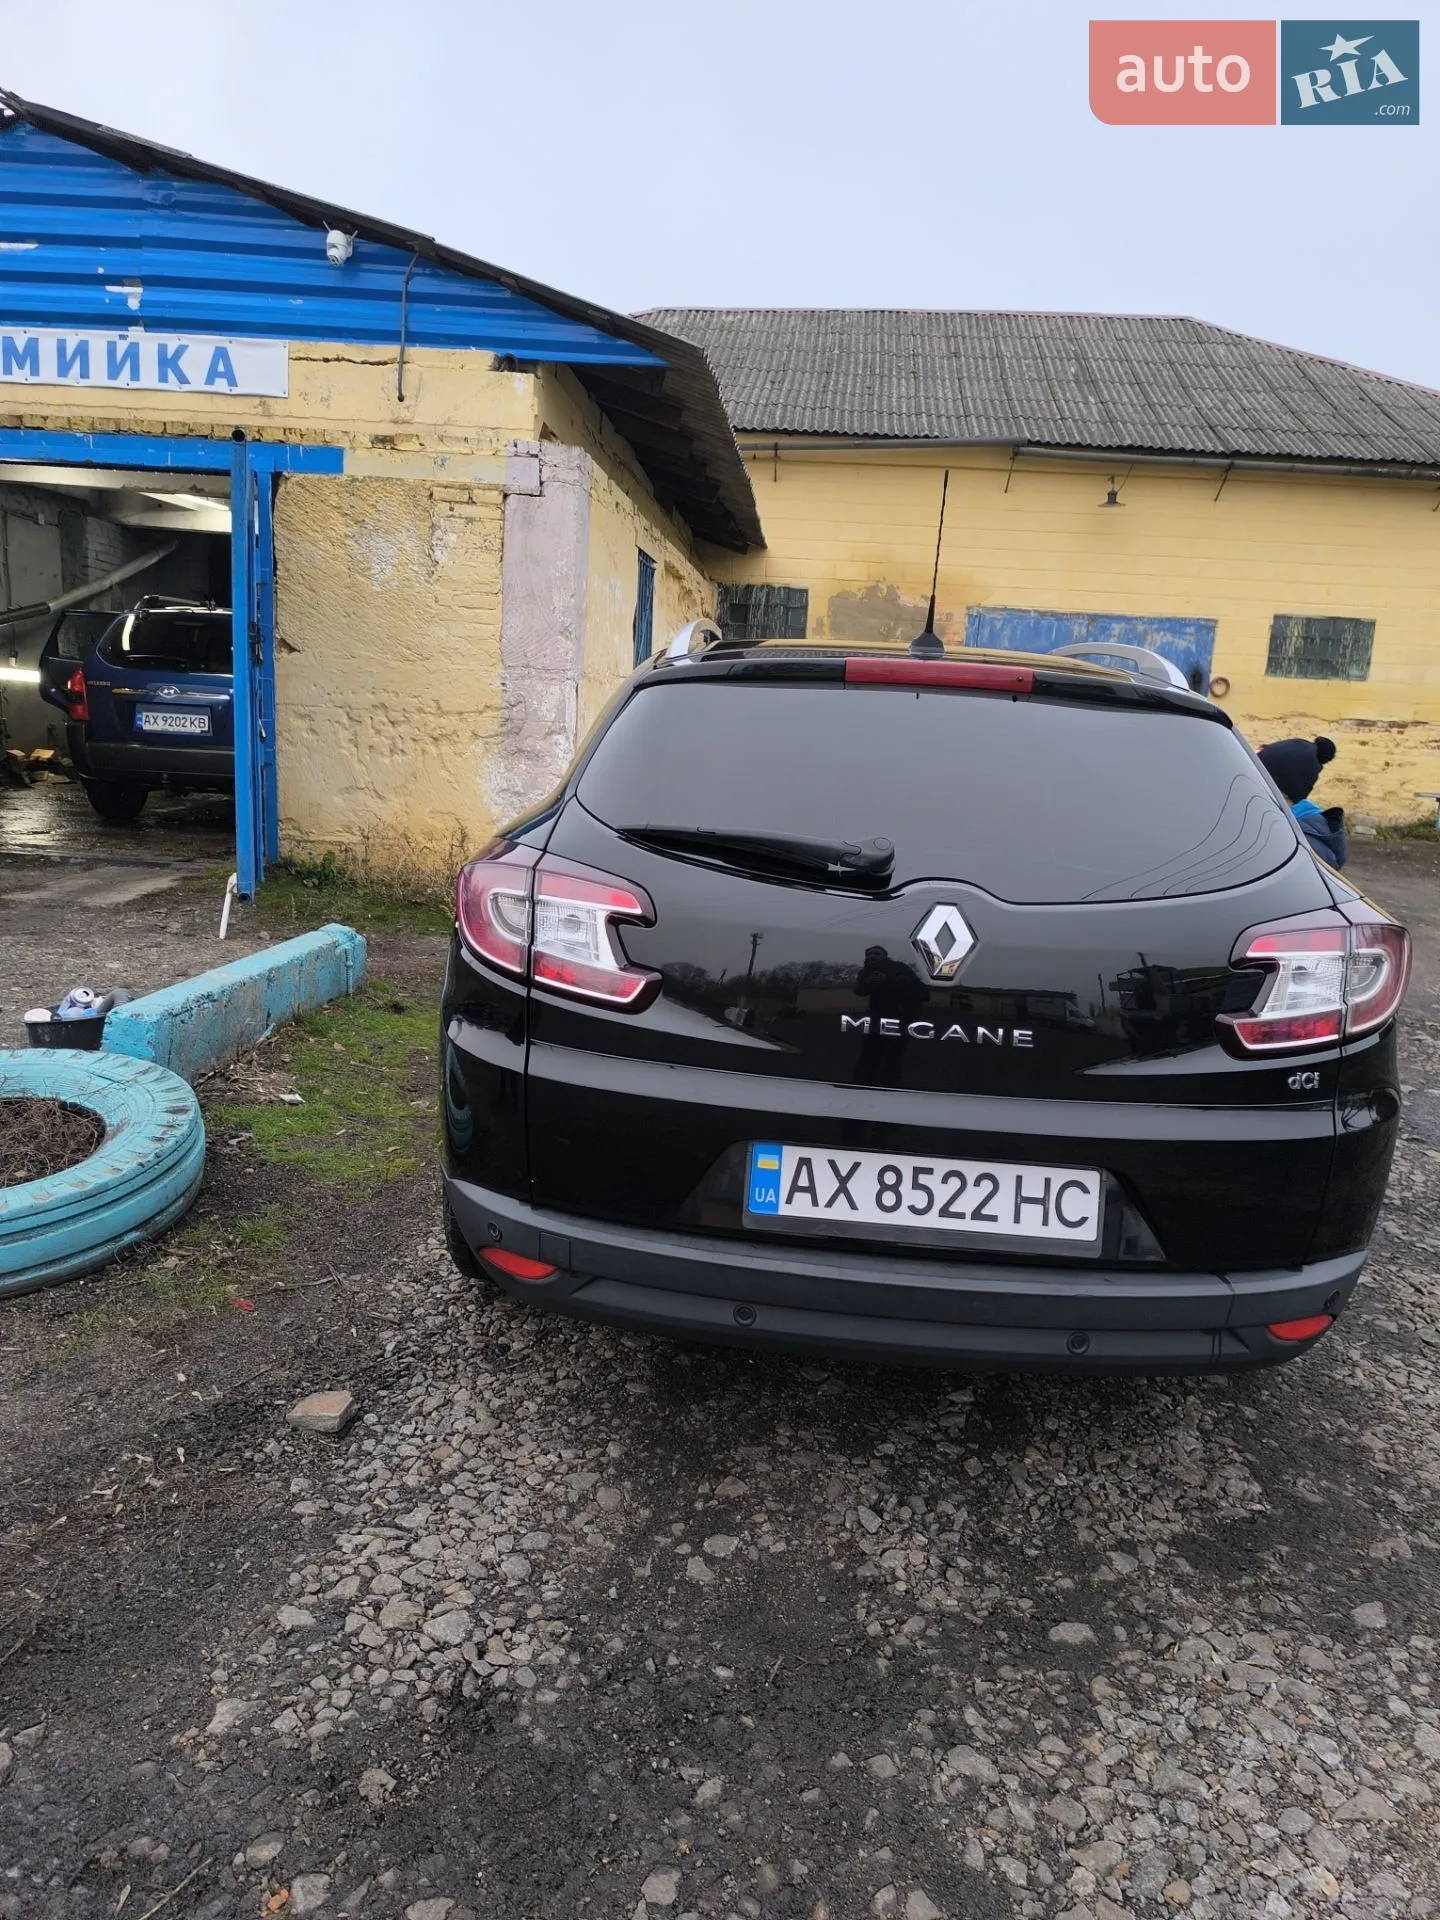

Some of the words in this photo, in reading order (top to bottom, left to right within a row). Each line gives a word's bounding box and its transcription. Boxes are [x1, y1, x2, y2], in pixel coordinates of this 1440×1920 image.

[2, 334, 239, 388] МИЙКА
[144, 714, 159, 726] AX
[162, 715, 187, 728] 9202
[189, 716, 206, 729] KB
[840, 1014, 1034, 1048] MEGANE
[754, 1188, 777, 1204] UA
[784, 1156, 862, 1211] AX
[875, 1163, 1000, 1223] 8522
[1012, 1174, 1091, 1229] HC
